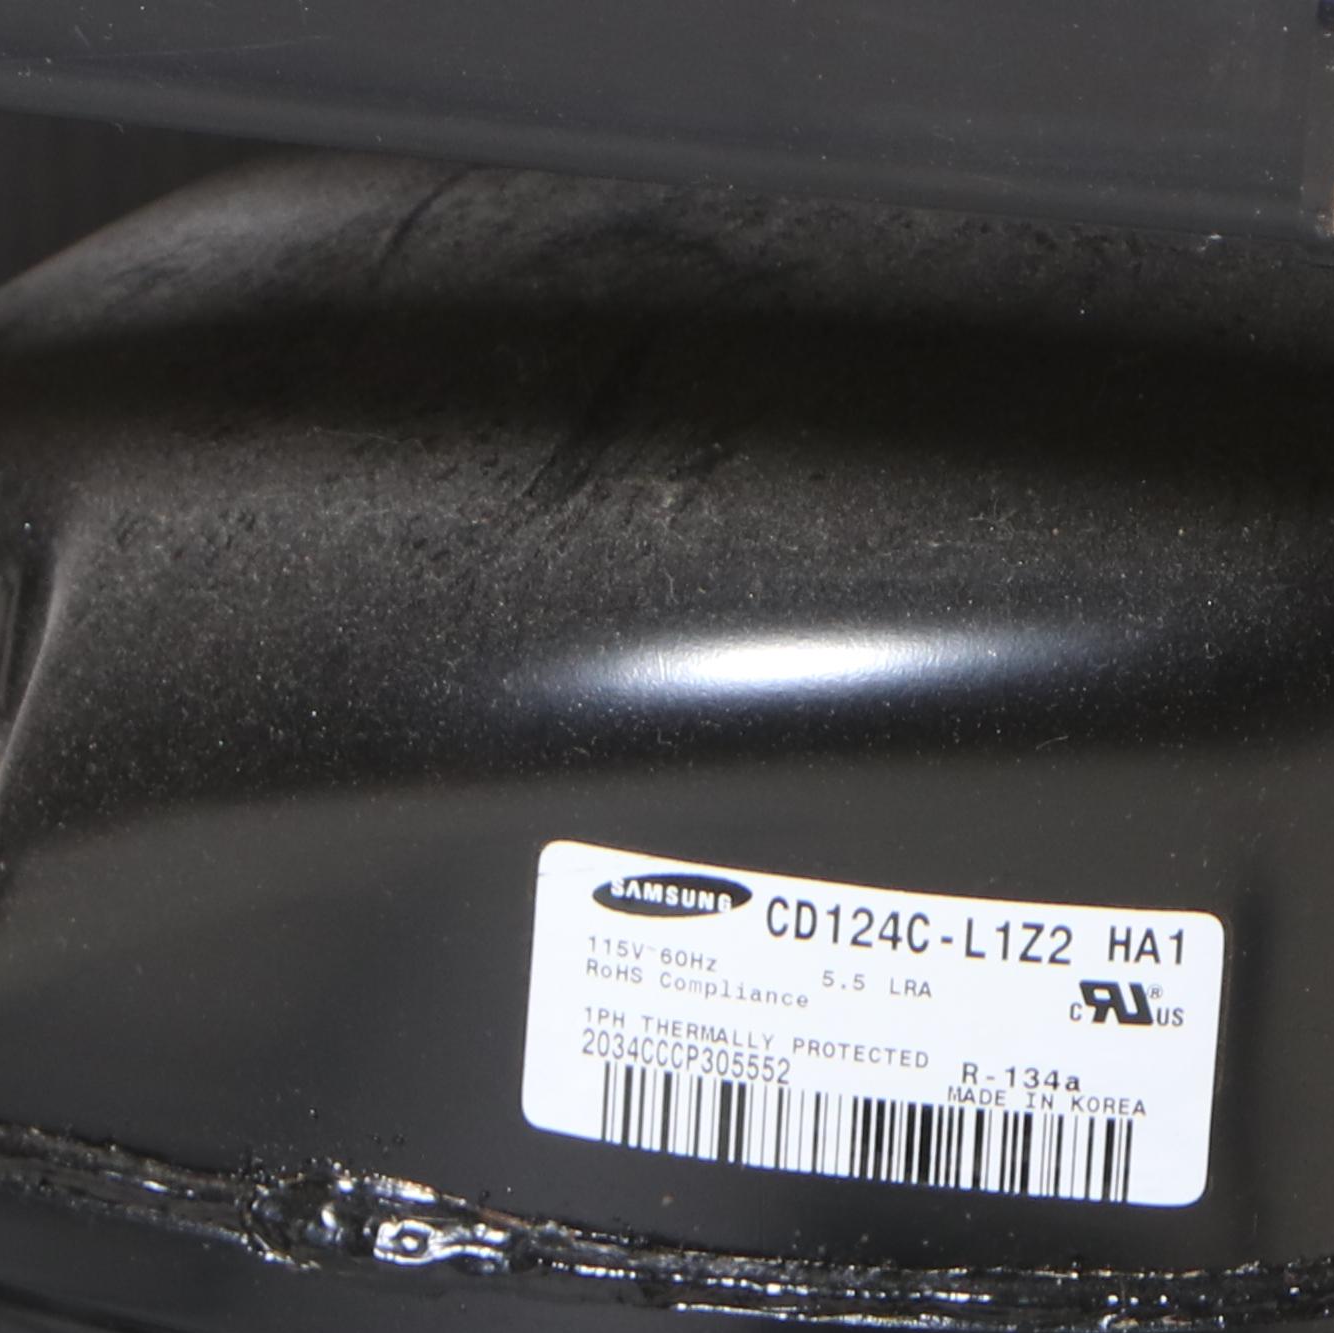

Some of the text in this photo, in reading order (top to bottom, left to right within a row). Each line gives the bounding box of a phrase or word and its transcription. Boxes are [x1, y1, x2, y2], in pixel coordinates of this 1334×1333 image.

[610, 878, 735, 914] SAMSUNG
[766, 896, 1185, 966] CD124C-L1Z2 HA1
[585, 958, 809, 1009] RoHS Compliance
[821, 970, 933, 999] 5.5 LRA
[581, 1027, 792, 1086] 2034CCCP305552
[583, 1006, 930, 1070] 1PH THERMALLY PROTECTED
[961, 1062, 1081, 1093] R-134a
[947, 1086, 1147, 1117] MADE IN KOREA
